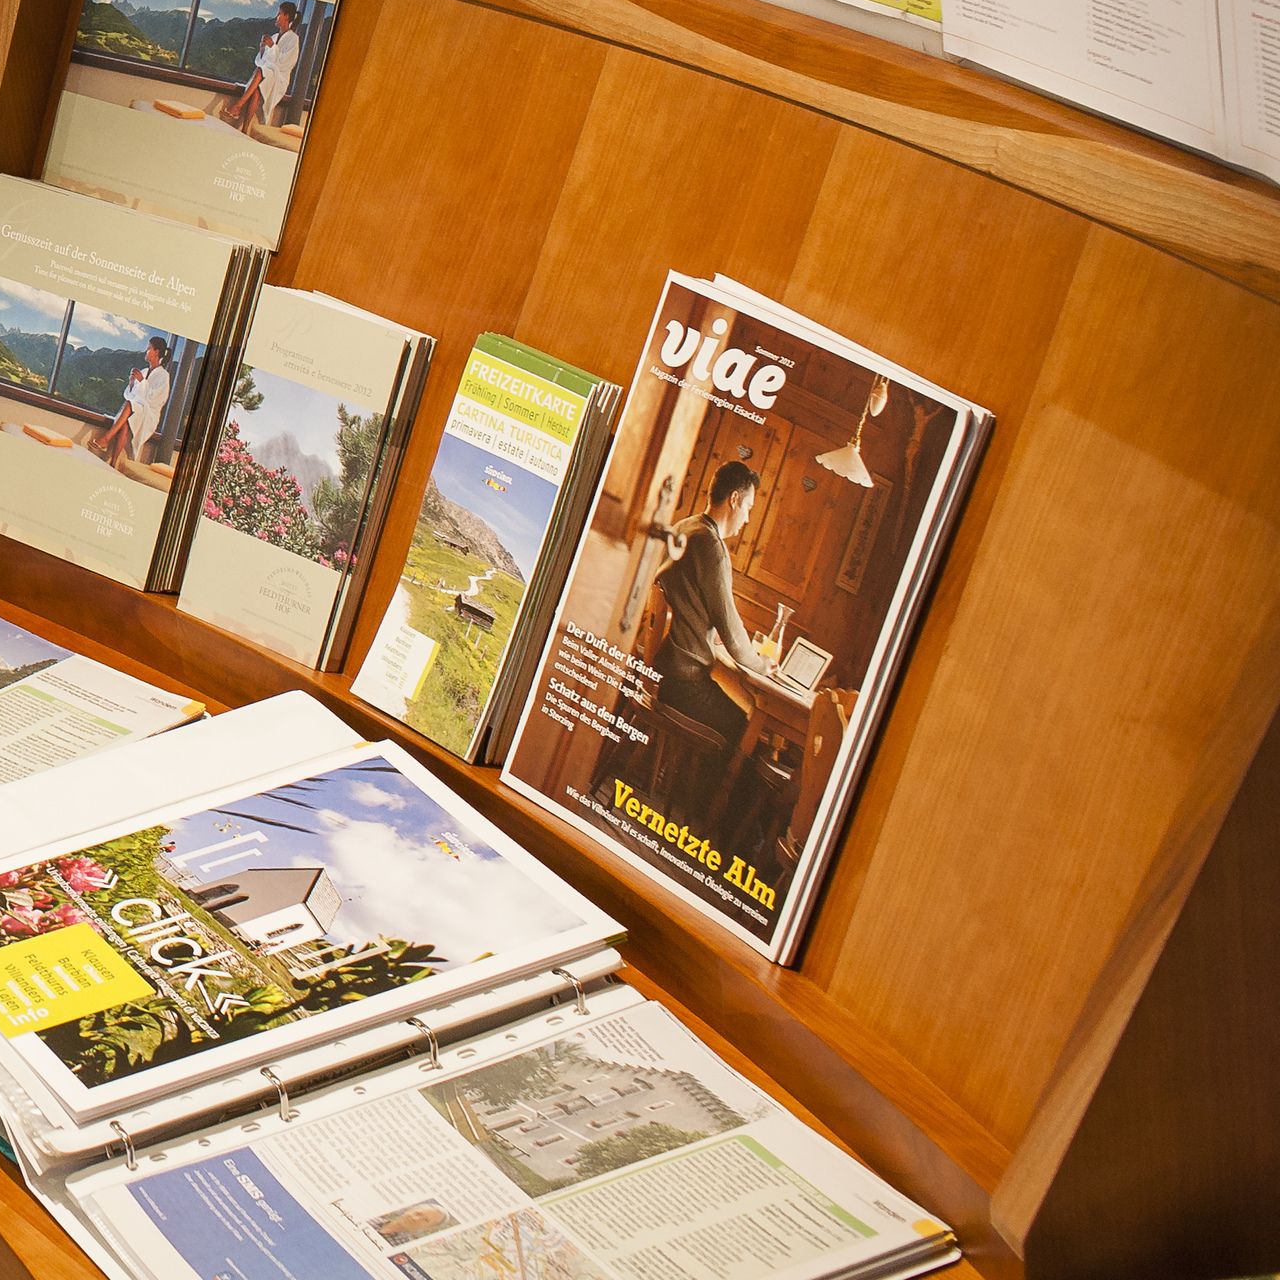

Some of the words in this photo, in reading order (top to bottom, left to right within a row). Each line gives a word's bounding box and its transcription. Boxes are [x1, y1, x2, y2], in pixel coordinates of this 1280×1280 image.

[213, 176, 266, 199] FELDTHURNER
[230, 191, 244, 202] HOF
[1, 224, 53, 252] Genusszeit
[54, 242, 71, 257] auf
[71, 246, 88, 262] der
[89, 251, 147, 280] Sonnenseite
[148, 271, 166, 287] der
[167, 276, 196, 297] Alpen
[270, 341, 315, 365] Programma
[660, 317, 787, 410] viae
[754, 345, 780, 362] Sommer
[778, 355, 796, 369] 2012
[317, 369, 352, 392] benessere
[352, 382, 373, 398] 2012
[468, 359, 578, 421] FREIZEITKARTE
[649, 365, 679, 384] Magazin
[678, 376, 692, 390] der
[691, 384, 735, 410] Ferienregion
[734, 403, 767, 426] Eisacktal
[463, 378, 497, 407] Frühling
[503, 397, 540, 421] Sommer
[546, 415, 571, 439] Herbst
[450, 418, 492, 445] primavera
[498, 439, 524, 460] estate
[528, 455, 559, 477] autunno
[456, 401, 505, 434] CARTINA
[508, 424, 562, 462] TURISTICA
[80, 508, 135, 537] FELDTHURNER
[96, 524, 115, 538] HOF
[257, 586, 312, 616] FELDTHURNER
[273, 602, 292, 616] HOF
[566, 620, 586, 638] Der
[585, 631, 608, 651] Duft
[608, 645, 626, 661] der
[625, 652, 665, 684] Kräuter
[554, 661, 598, 691] entscheidend
[545, 692, 558, 707] Die
[556, 699, 581, 718] Spuren
[579, 711, 591, 725] des
[590, 718, 622, 744] Bergbaus
[547, 677, 581, 705] Schatz
[580, 697, 598, 715] aus
[597, 705, 616, 725] den
[615, 716, 651, 746] Bergen
[548, 708, 575, 732] Sterzing
[565, 784, 580, 799] Wie
[579, 792, 592, 808] das
[591, 800, 622, 827] Villnösser
[621, 820, 631, 834] Tal
[637, 831, 661, 855] schafft,
[660, 846, 694, 876] Innovation
[692, 867, 706, 883] mit
[704, 874, 736, 903] Ökologie
[741, 900, 770, 927] vereinen
[613, 778, 723, 872] Vernetzte
[723, 854, 777, 912] Alm
[80, 948, 117, 982] Klausen
[111, 897, 236, 993] click
[3, 963, 46, 1005] Villanders
[24, 953, 70, 998] Feldthurns
[56, 956, 92, 990] Barbian
